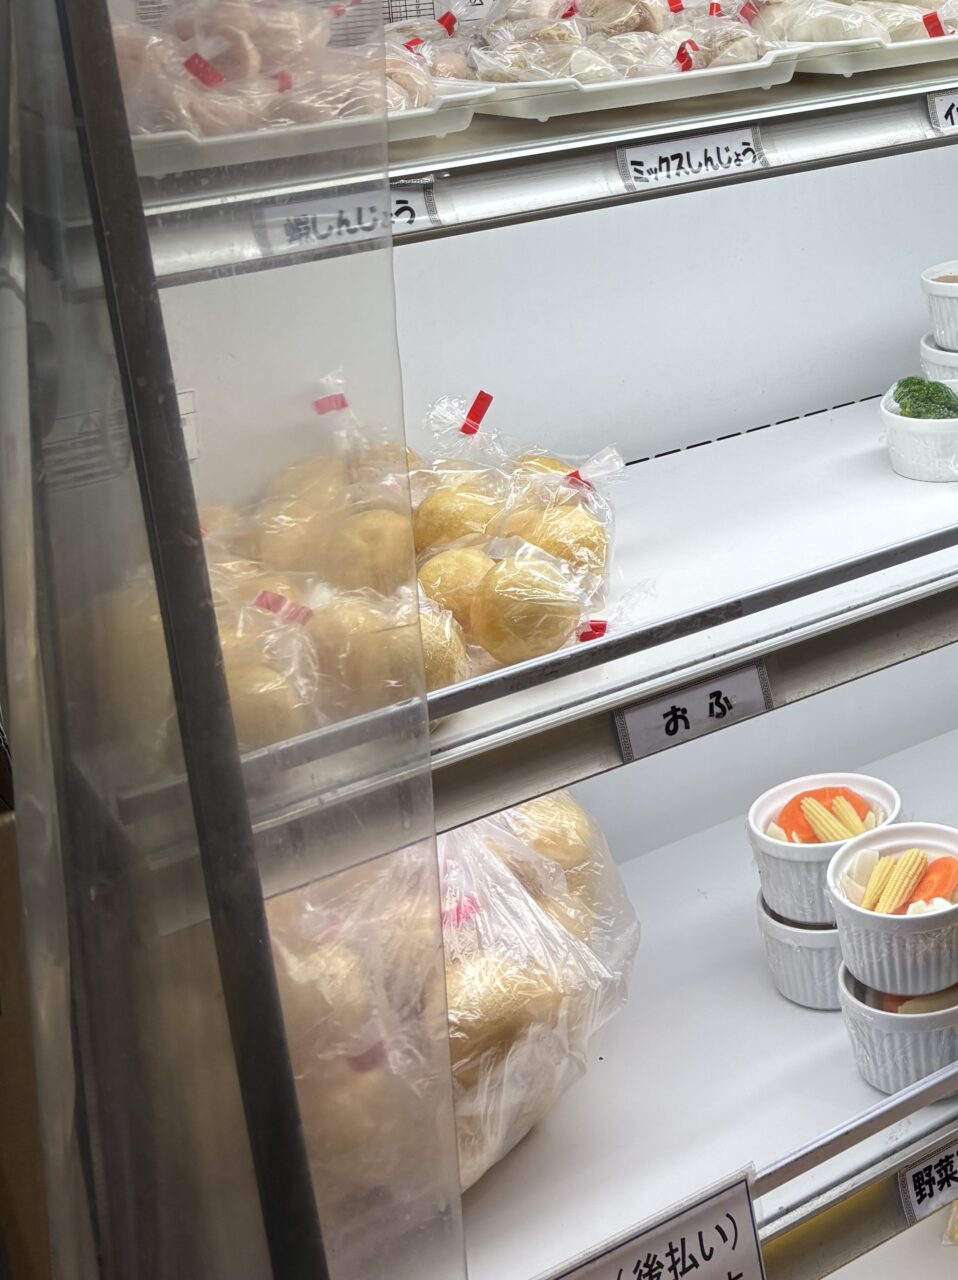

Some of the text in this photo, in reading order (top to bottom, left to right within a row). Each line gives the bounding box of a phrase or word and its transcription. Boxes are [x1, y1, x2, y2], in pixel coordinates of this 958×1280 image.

[630, 141, 758, 184] ミックスしんじょう
[662, 690, 734, 737] おふ
